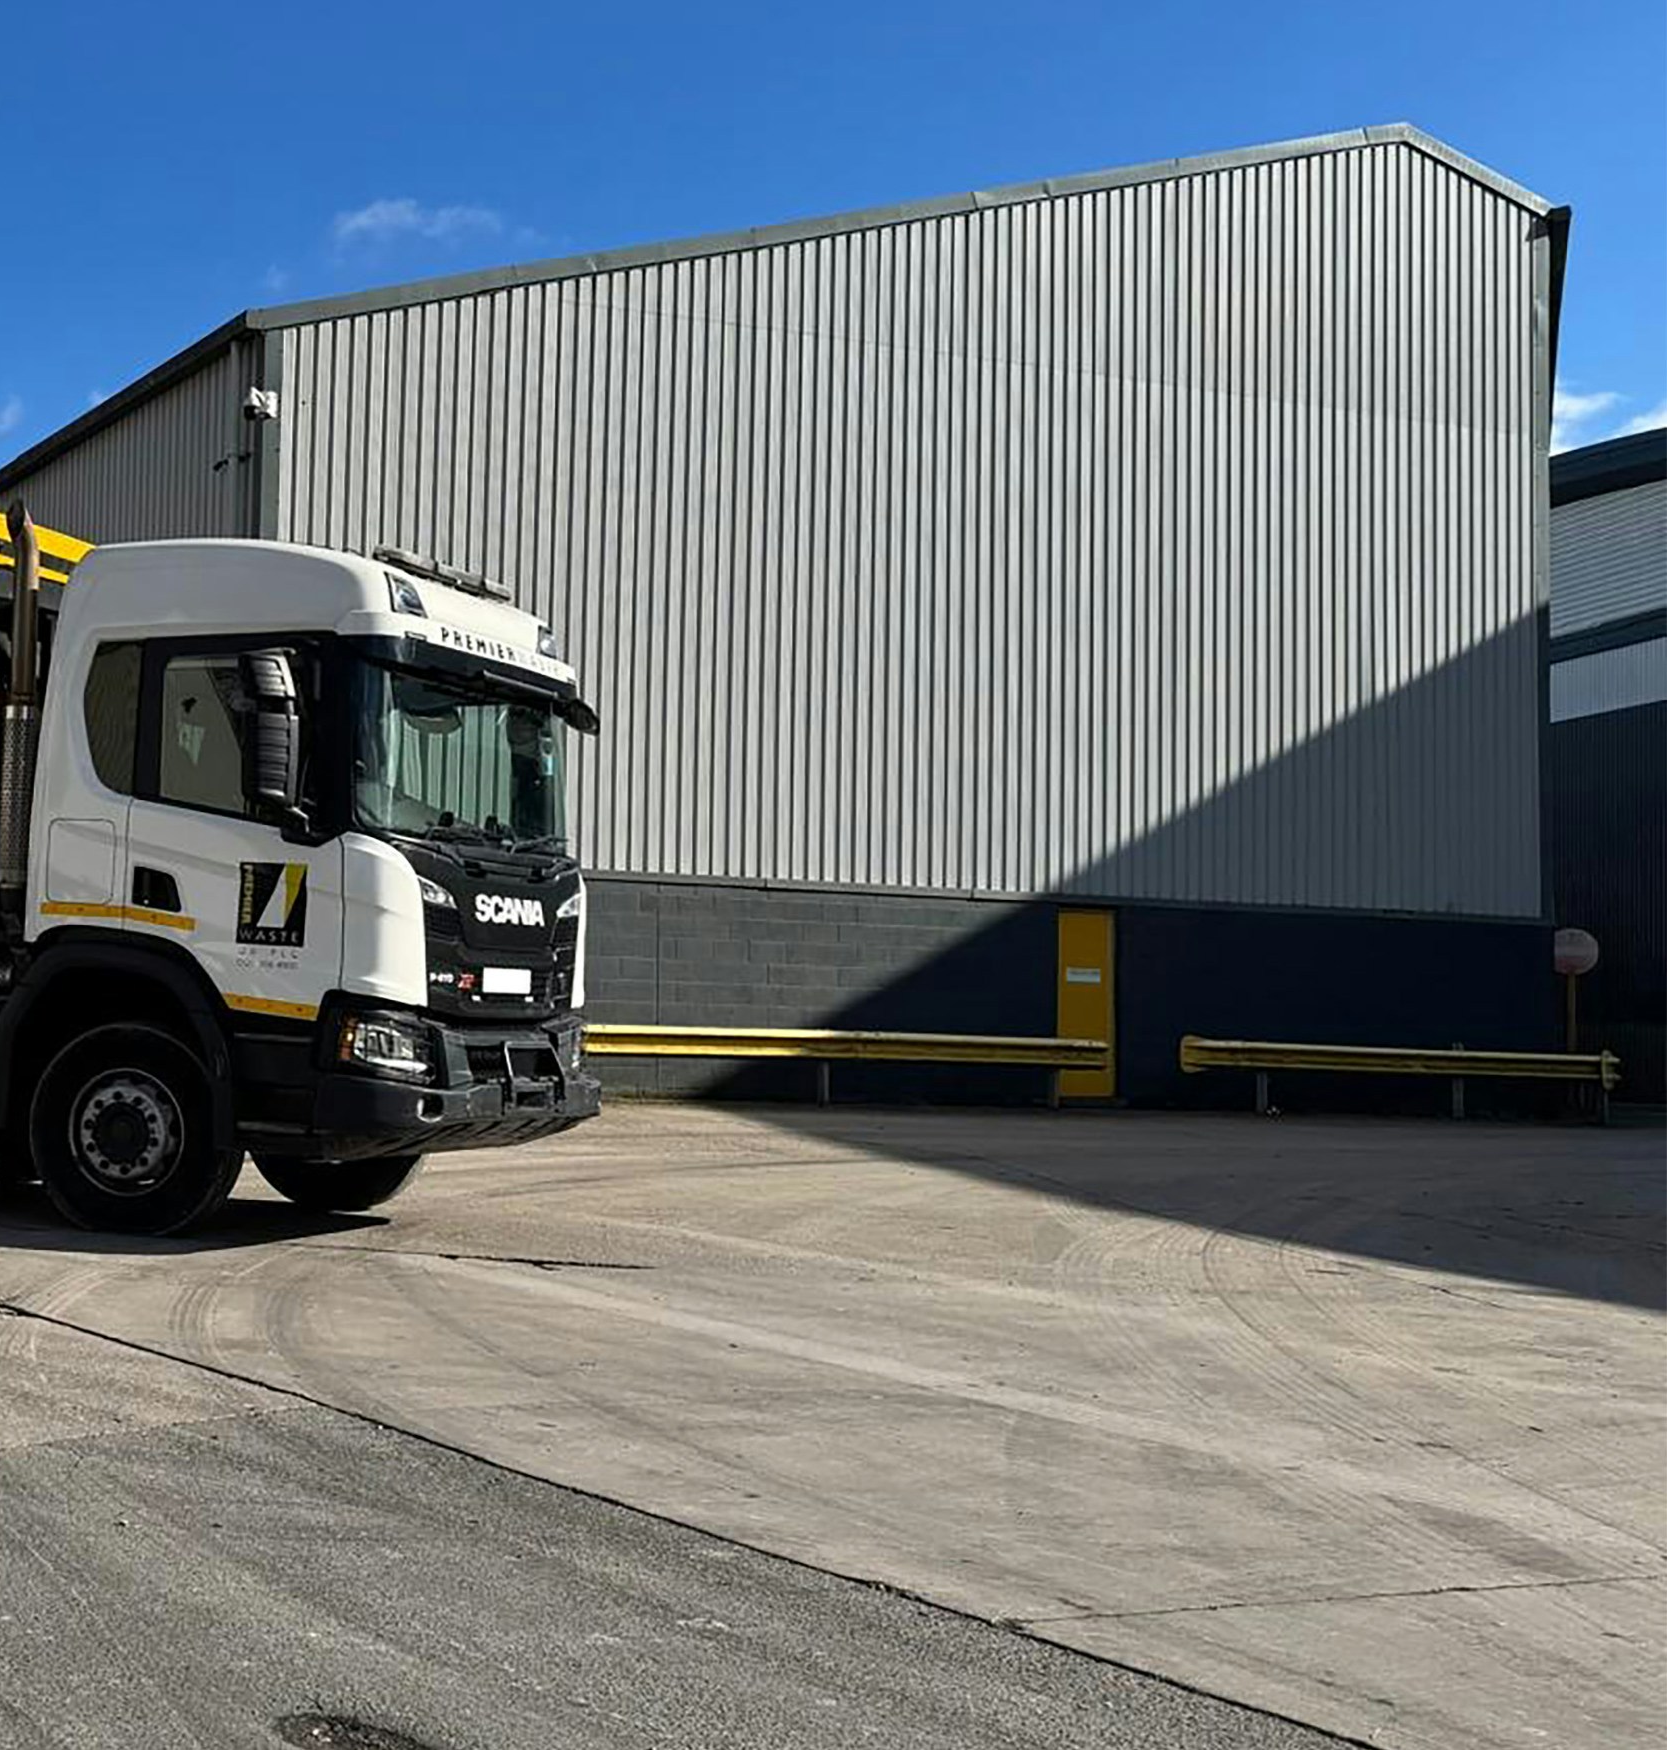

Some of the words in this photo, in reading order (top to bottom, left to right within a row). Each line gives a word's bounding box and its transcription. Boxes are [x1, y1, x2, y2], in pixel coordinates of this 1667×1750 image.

[440, 626, 517, 662] PREMIER
[475, 893, 545, 927] SCANIA
[238, 928, 300, 944] WASTE
